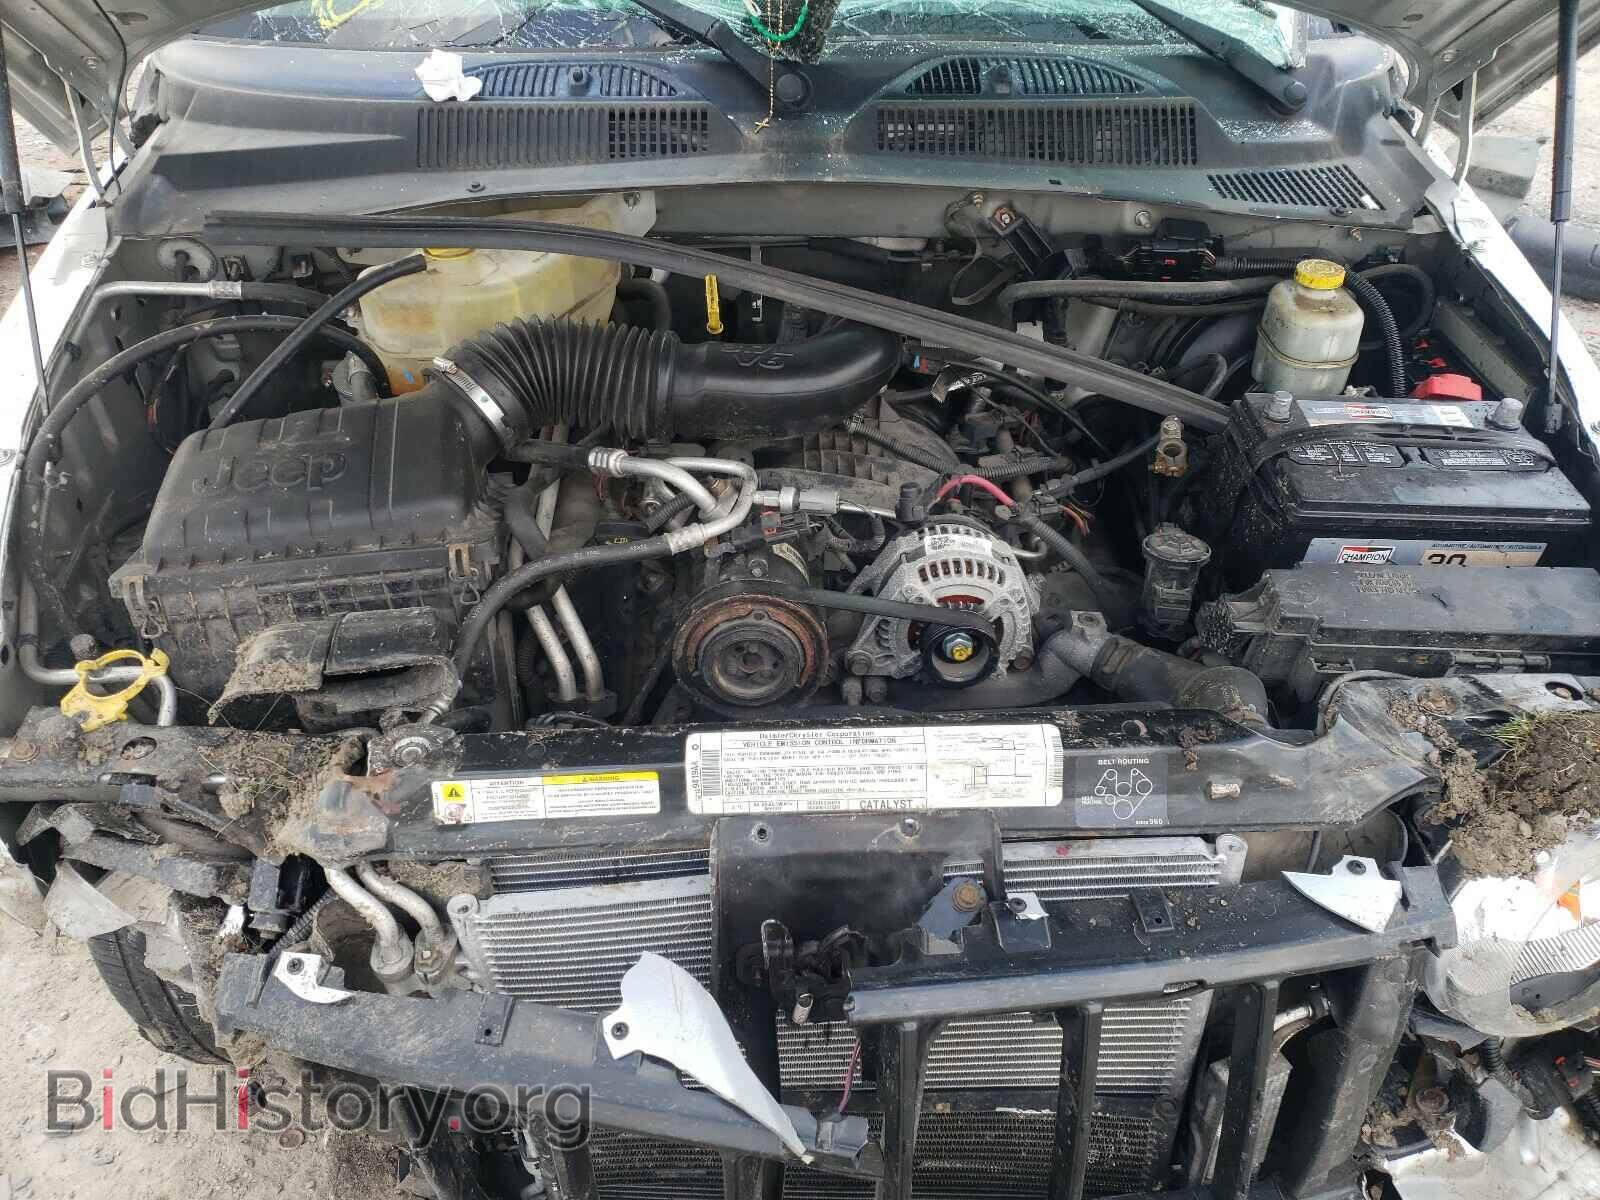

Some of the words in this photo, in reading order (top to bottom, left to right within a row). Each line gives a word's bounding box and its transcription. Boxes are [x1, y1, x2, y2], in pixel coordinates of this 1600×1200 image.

[1341, 552, 1388, 562] CHAMPION
[743, 740, 773, 748] VEHICLE
[776, 739, 811, 747] EMISSION
[815, 738, 844, 746] CONTROL
[850, 737, 897, 745] INFORMATION
[860, 799, 913, 810] CATALYST
